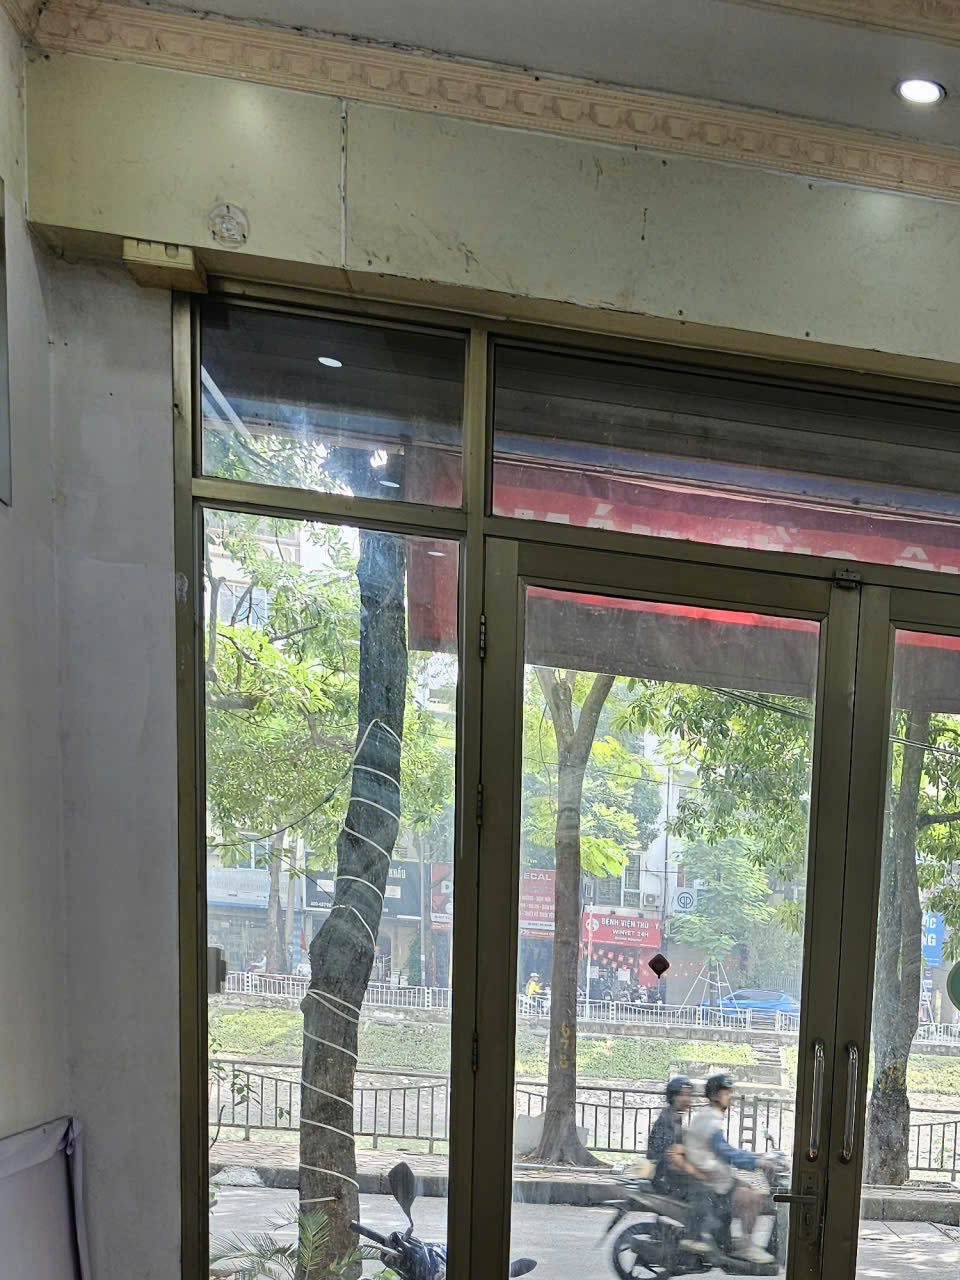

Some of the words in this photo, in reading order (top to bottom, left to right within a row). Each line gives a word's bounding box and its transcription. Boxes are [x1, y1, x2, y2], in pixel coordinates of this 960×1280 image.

[520, 872, 552, 880] ECAL
[601, 918, 619, 926] BỆNH
[621, 920, 636, 929] VIỆN
